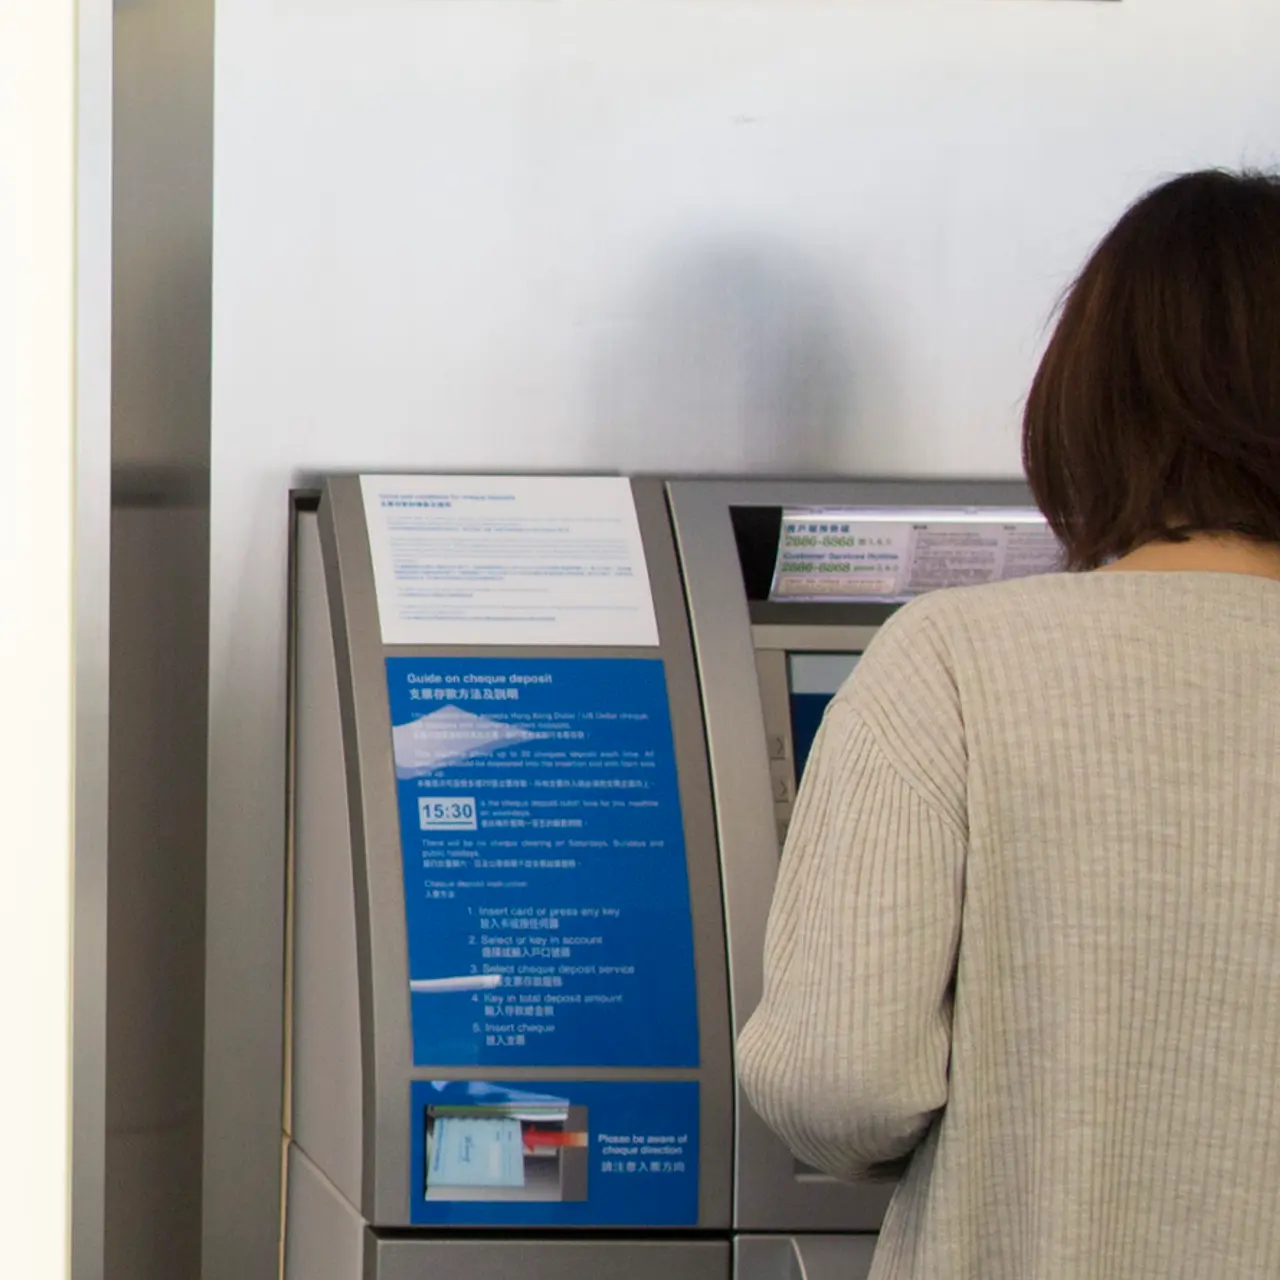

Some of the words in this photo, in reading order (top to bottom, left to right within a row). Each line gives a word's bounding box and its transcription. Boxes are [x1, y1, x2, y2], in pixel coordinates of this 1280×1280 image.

[406, 673, 443, 684] Guide
[445, 674, 461, 684] on
[463, 673, 507, 686] cheque
[509, 673, 553, 686] deposit
[422, 804, 473, 819] 15:30
[478, 906, 509, 917] Insert
[510, 907, 534, 917] card
[536, 907, 548, 917] or
[549, 908, 578, 918] press
[602, 907, 621, 918] key
[480, 935, 513, 945] Select
[515, 936, 527, 945] or
[562, 936, 603, 945] account
[516, 965, 556, 975] cheque
[558, 965, 597, 976] deposit
[484, 994, 504, 1006] Key
[506, 994, 517, 1004] in
[544, 994, 582, 1006] deposit
[484, 1023, 516, 1033] Insert
[517, 1024, 556, 1034] cheque
[598, 1133, 631, 1144] Please
[632, 1133, 645, 1144] be
[647, 1134, 676, 1144] aware
[677, 1133, 689, 1143] of
[602, 1145, 639, 1156] cheque
[640, 1145, 683, 1155] direction
